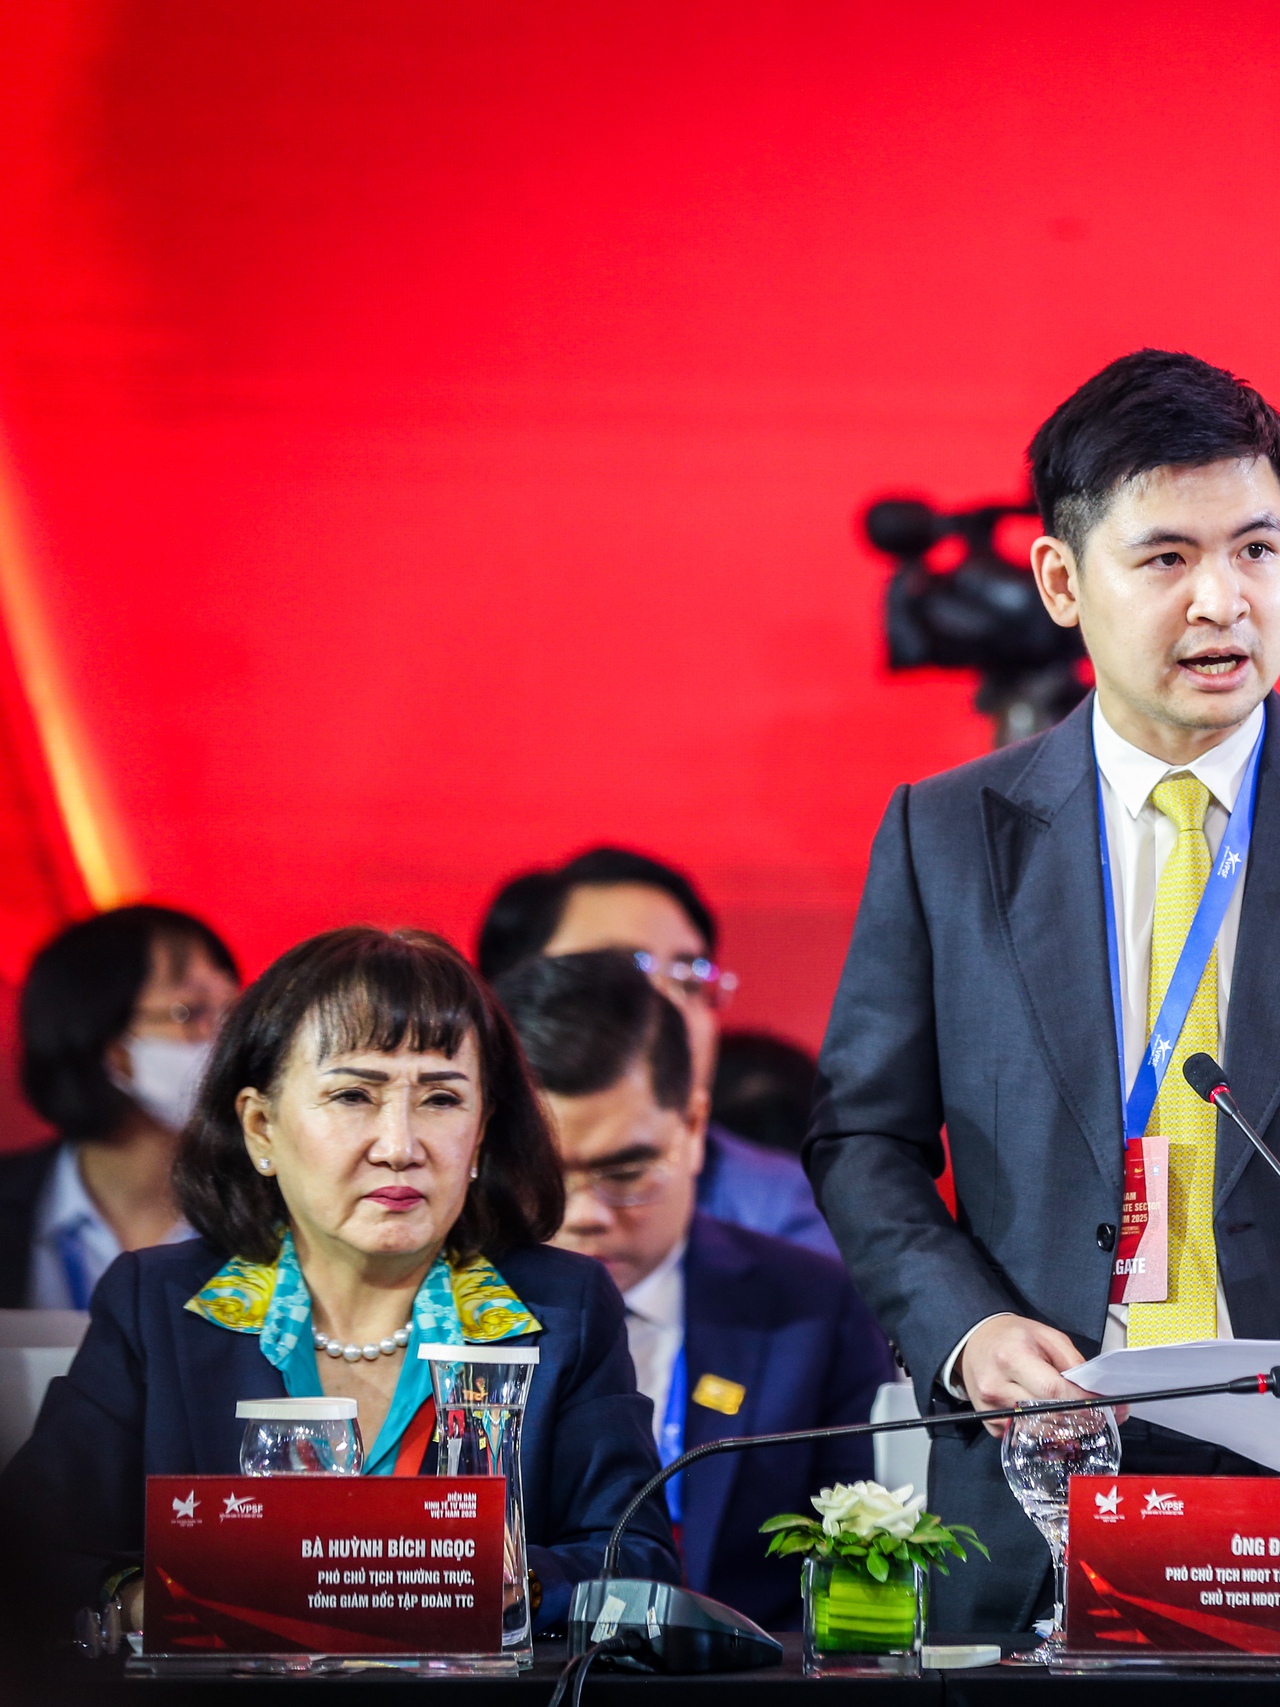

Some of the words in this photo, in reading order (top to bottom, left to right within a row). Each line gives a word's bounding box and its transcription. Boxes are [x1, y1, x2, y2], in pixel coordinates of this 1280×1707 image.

[1131, 1214, 1148, 1223] 2025
[1113, 1258, 1146, 1275] GATE
[240, 1504, 264, 1514] VPSF
[424, 1501, 440, 1510] KINH
[1160, 1501, 1184, 1511] VPSF
[302, 1535, 324, 1558] BÀ
[328, 1535, 382, 1558] HUỲNH
[388, 1535, 426, 1558] BÍCH
[430, 1538, 476, 1561] NGỌC
[1231, 1533, 1266, 1556] ÔNG
[318, 1568, 340, 1584] PHÓ
[344, 1566, 366, 1584] CHỦ
[368, 1570, 394, 1587] TỊCH
[396, 1567, 440, 1584] THƯỜNG
[443, 1569, 475, 1586] TRỰC,
[1165, 1565, 1188, 1582] PHÓ
[1190, 1564, 1214, 1582] CHỦ
[1214, 1567, 1240, 1584] TỊCH
[1242, 1568, 1271, 1584] HĐQT
[308, 1590, 336, 1608] TỔNG
[340, 1592, 369, 1608] GIÁM
[372, 1590, 394, 1608] ĐỐC
[397, 1592, 418, 1610] TẬP
[421, 1592, 452, 1608] ĐOÀN
[454, 1594, 474, 1608] TTC
[1200, 1588, 1224, 1606] CHỦ
[1224, 1592, 1250, 1608] TỊCH
[1252, 1592, 1280, 1608] HĐQT
